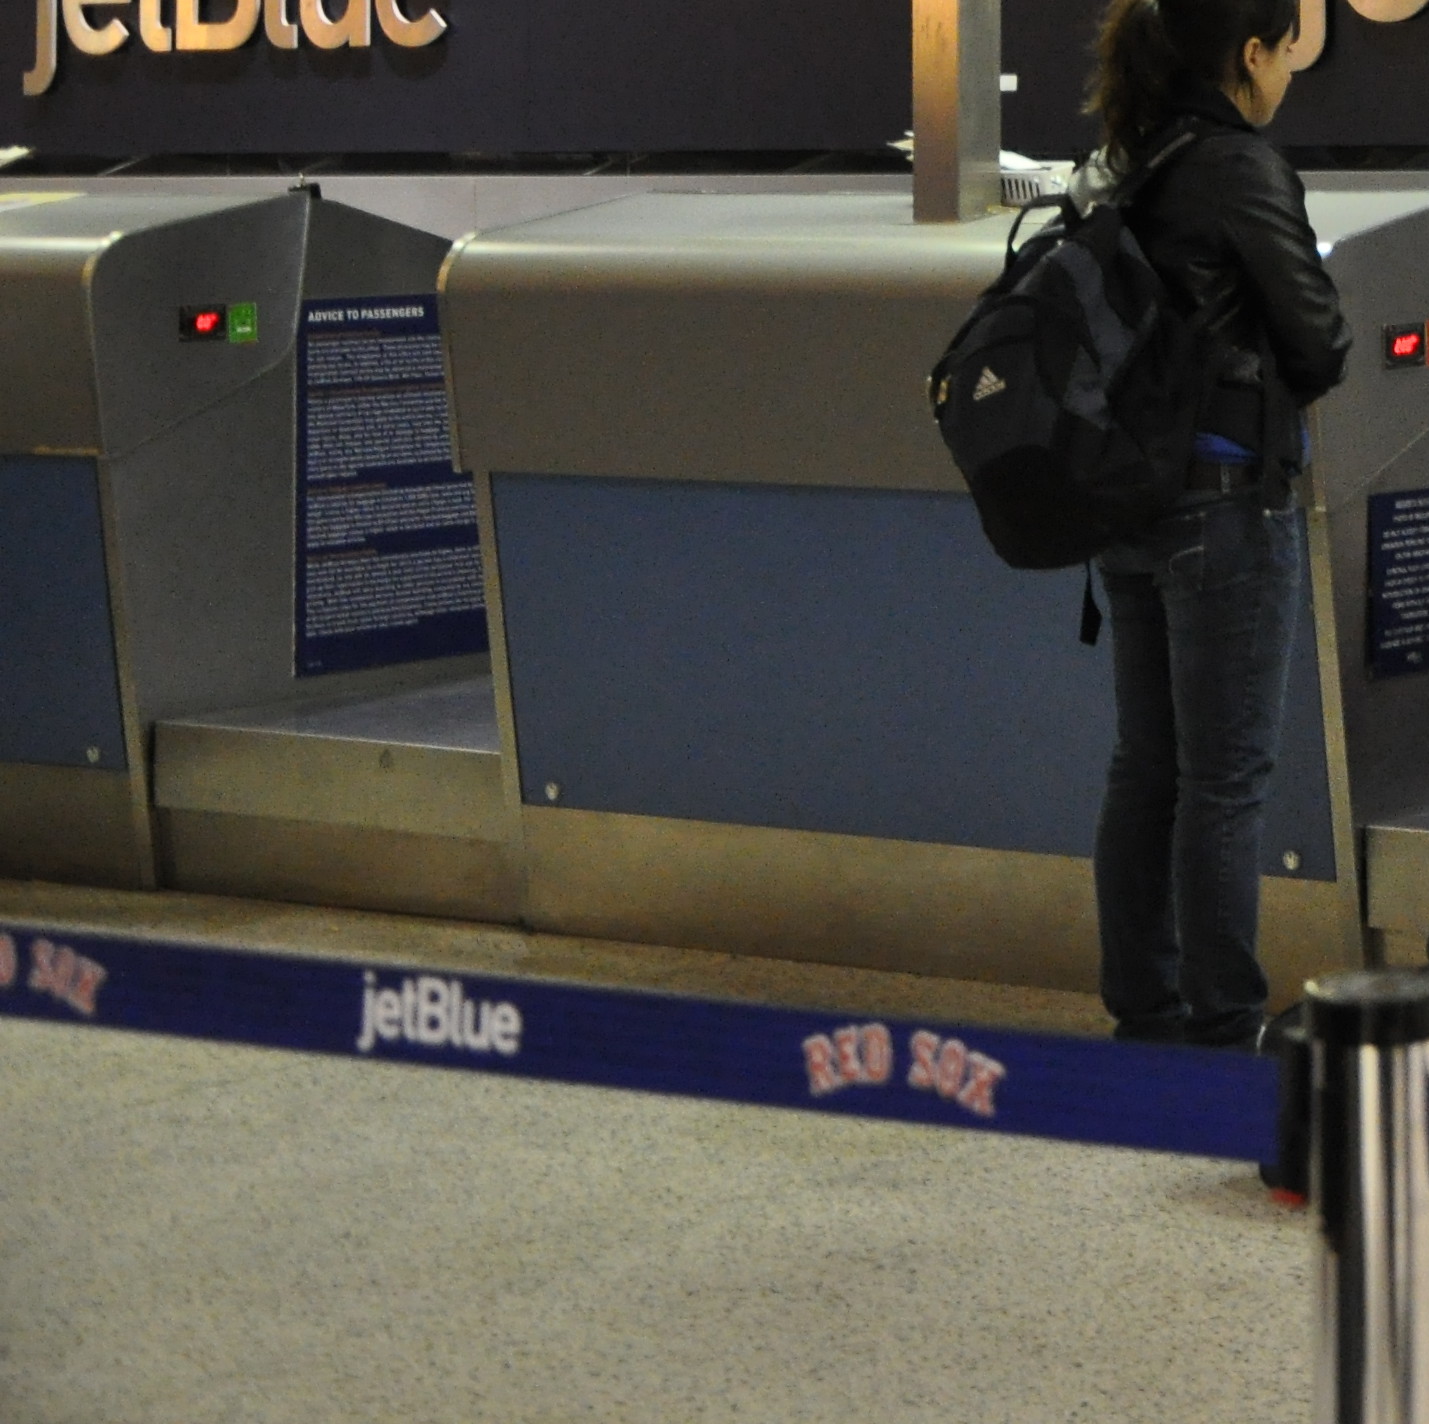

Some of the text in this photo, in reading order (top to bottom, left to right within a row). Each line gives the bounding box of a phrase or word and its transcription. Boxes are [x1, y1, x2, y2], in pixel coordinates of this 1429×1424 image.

[308, 306, 425, 323] ADVICE TO PASSENGERS
[357, 971, 523, 1056] jetBlue
[803, 1022, 1006, 1117] RED SOX
